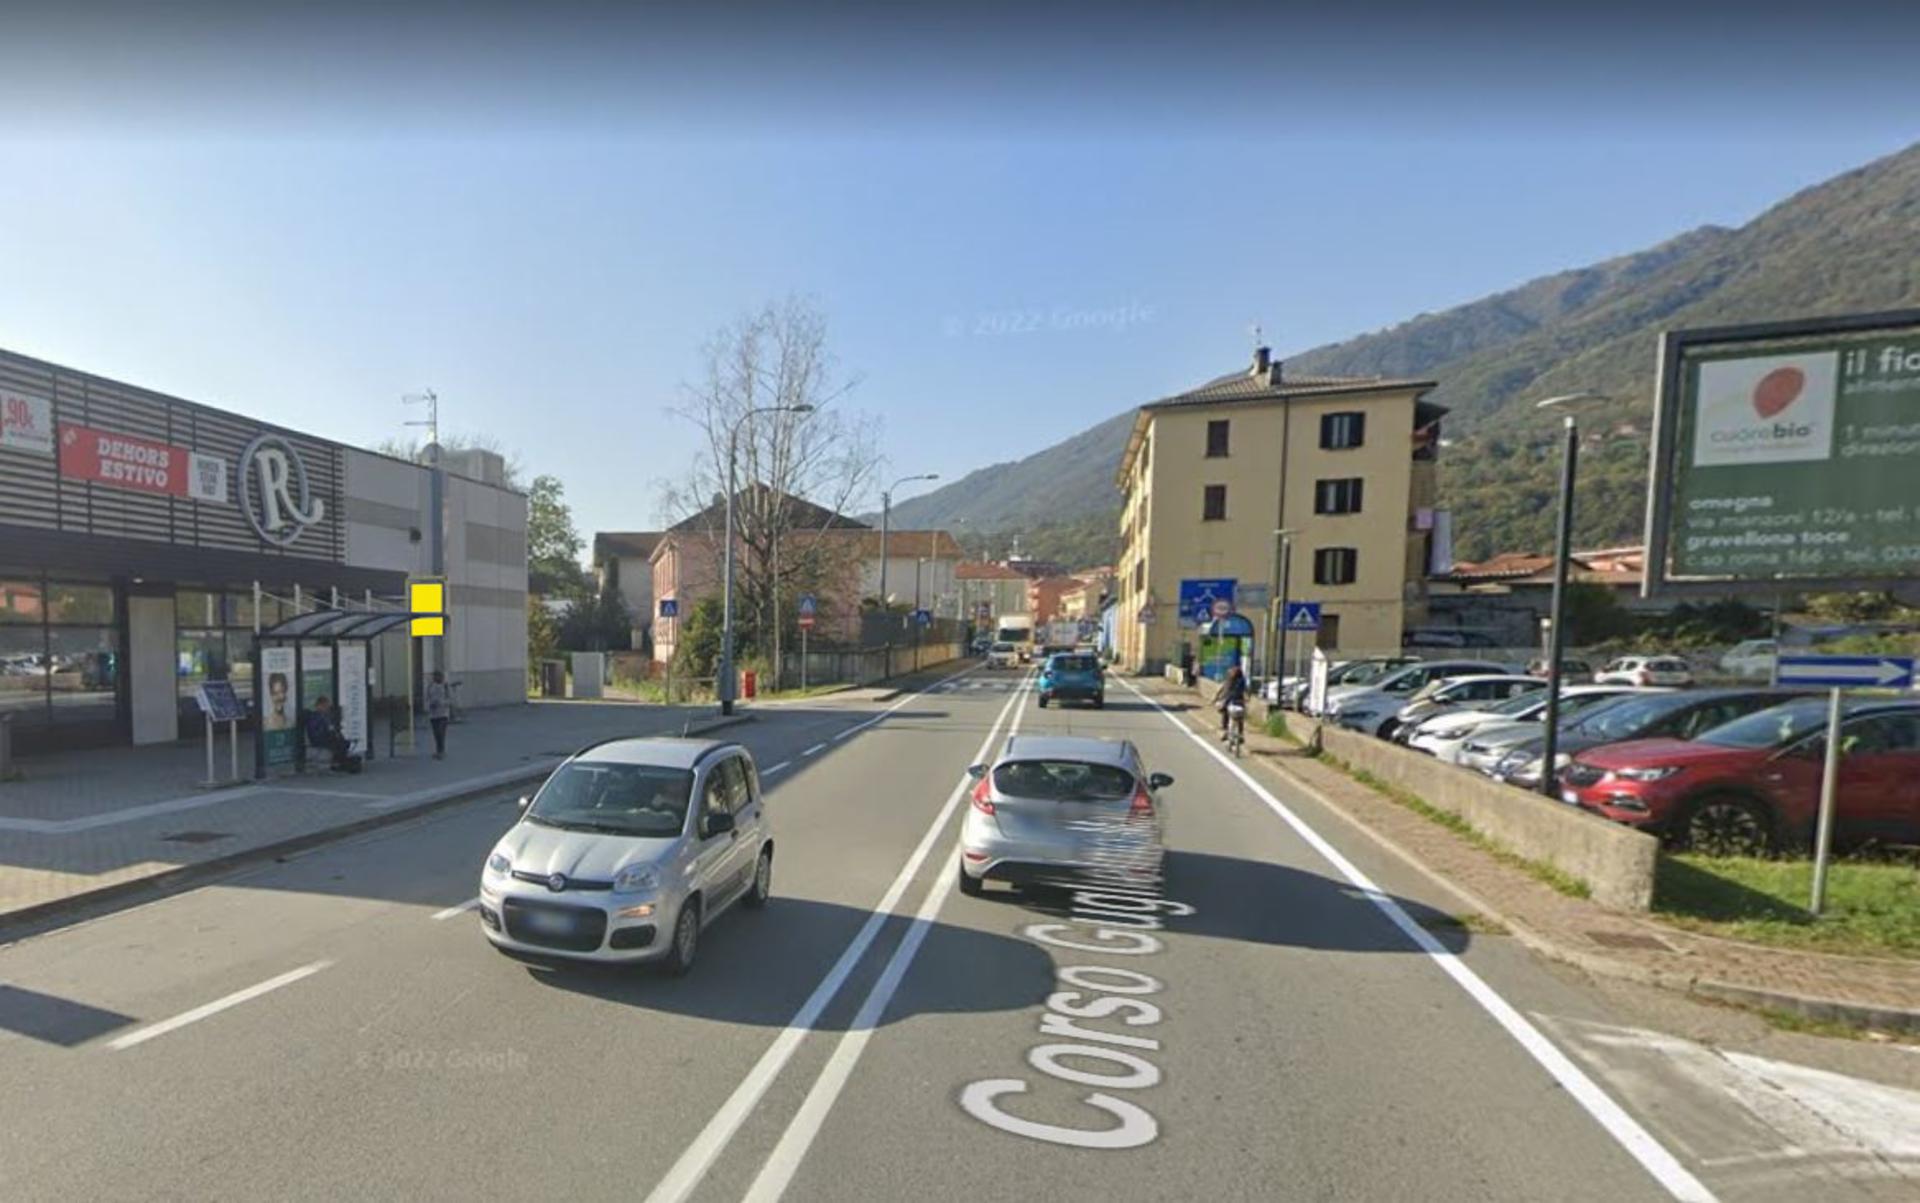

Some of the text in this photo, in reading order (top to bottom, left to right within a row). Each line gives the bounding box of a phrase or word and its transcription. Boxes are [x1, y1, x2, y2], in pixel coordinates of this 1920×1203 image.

[1845, 348, 1867, 376] il
[98, 438, 169, 468] DEHORS
[101, 459, 168, 487] ESTIVO
[253, 447, 325, 532] R
[1686, 530, 1850, 551] gravellona toce
